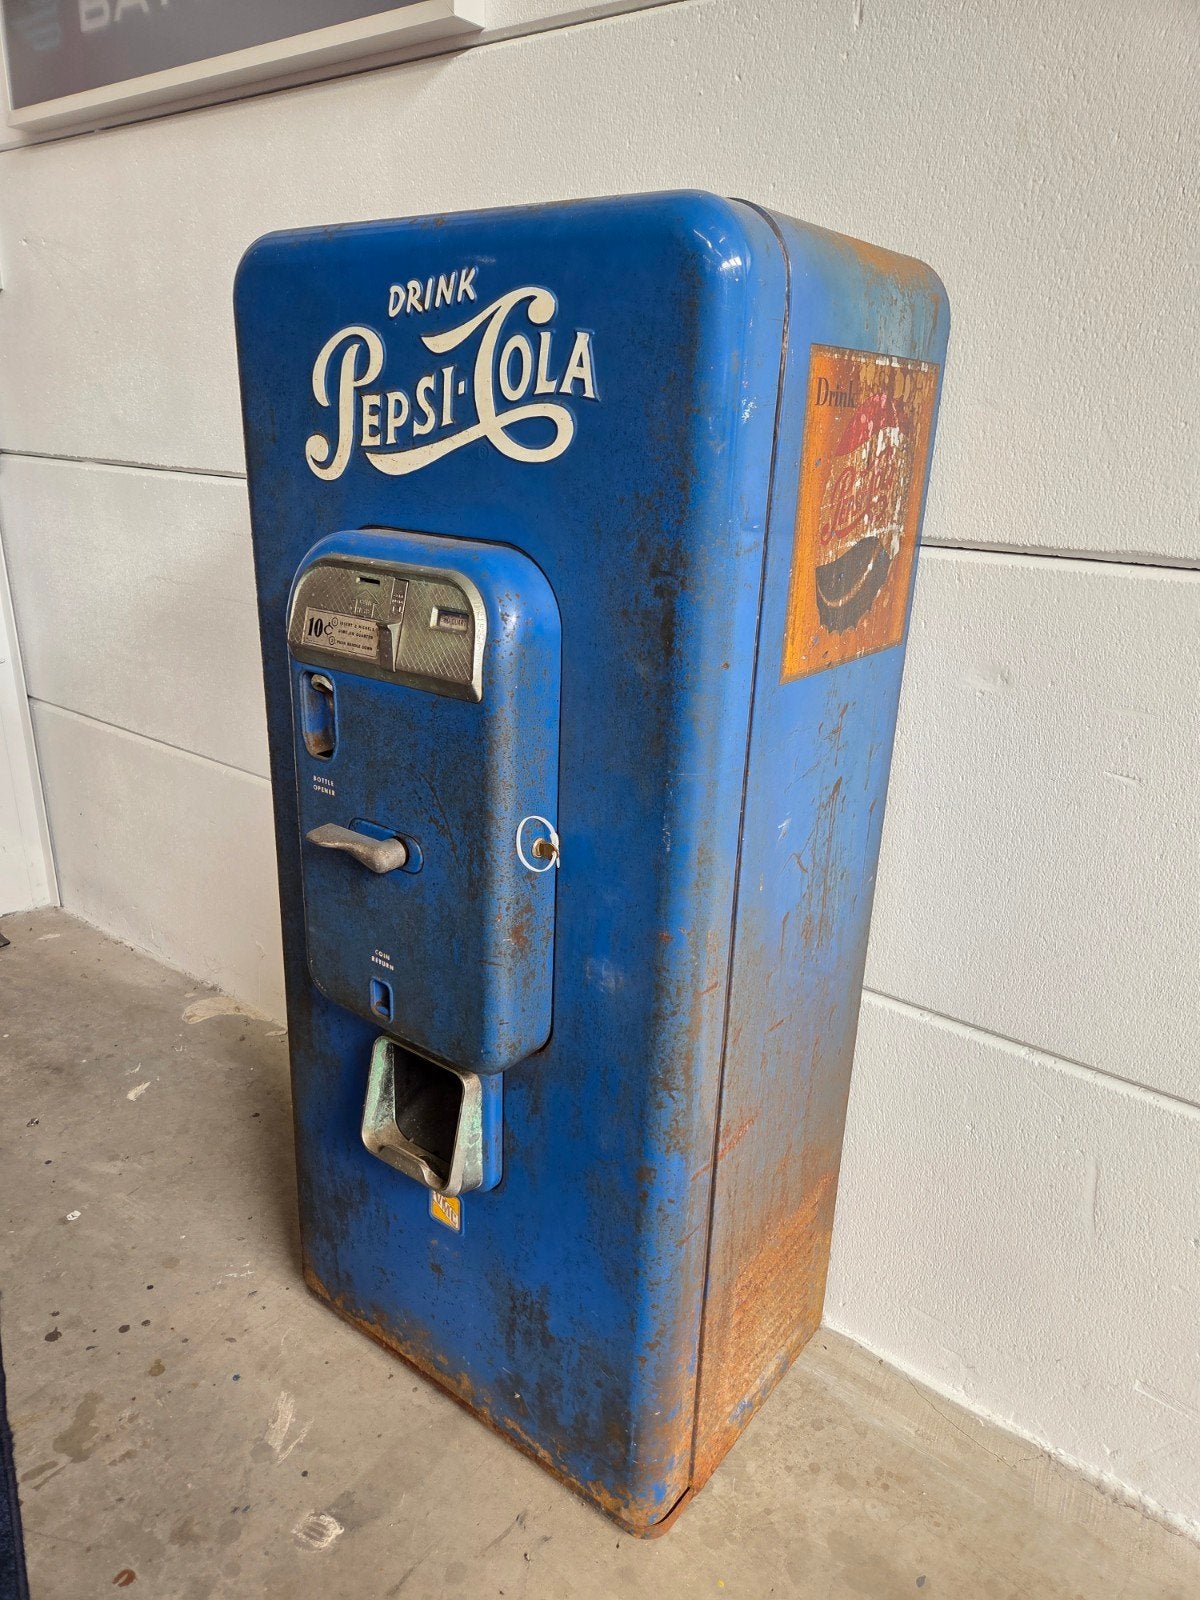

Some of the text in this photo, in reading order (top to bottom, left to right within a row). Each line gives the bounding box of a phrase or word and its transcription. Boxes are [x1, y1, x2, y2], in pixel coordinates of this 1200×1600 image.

[387, 266, 479, 318] DRINK
[815, 377, 857, 407] Drink
[313, 775, 334, 787] BOTTLE
[313, 784, 336, 796] OPENER
[375, 949, 390, 961] COIN
[371, 955, 394, 971] RETURN
